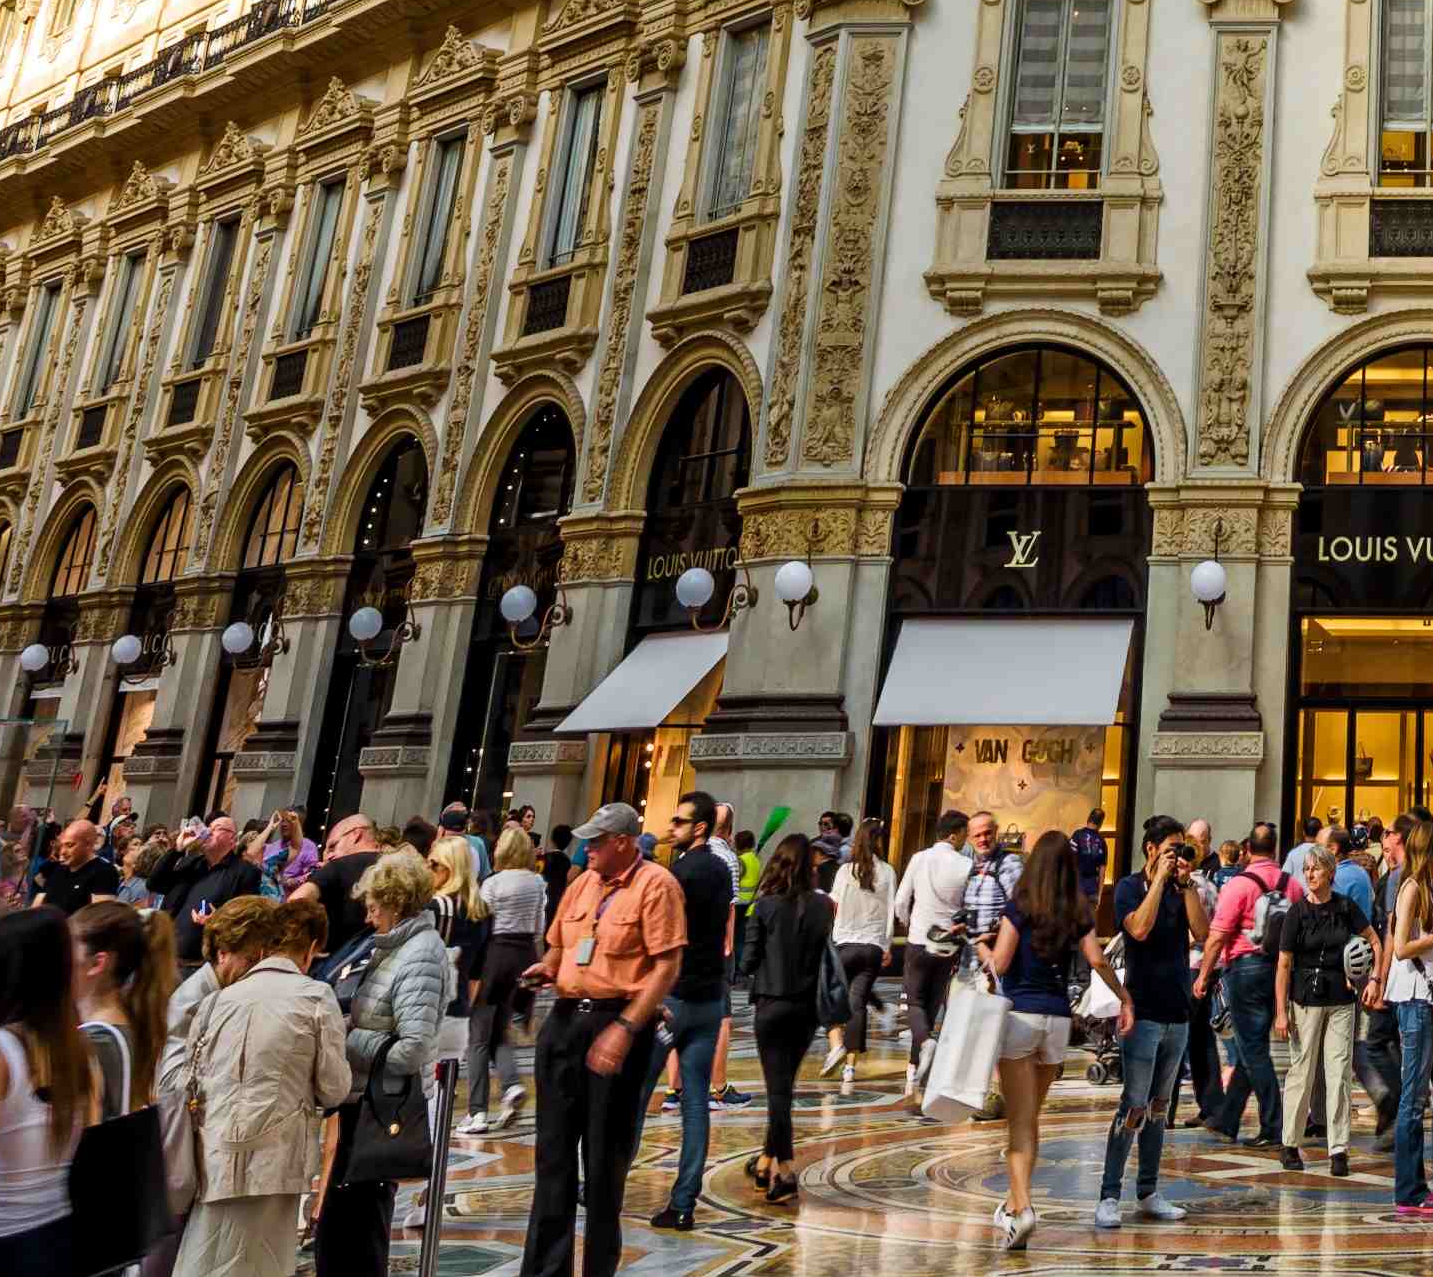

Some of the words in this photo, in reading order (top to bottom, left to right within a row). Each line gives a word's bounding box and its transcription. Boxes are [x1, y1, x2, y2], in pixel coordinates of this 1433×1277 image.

[1318, 536, 1399, 562] LOUIS
[647, 551, 688, 580] LOUIS
[689, 546, 738, 574] VUITTO
[974, 739, 1009, 764] VAN
